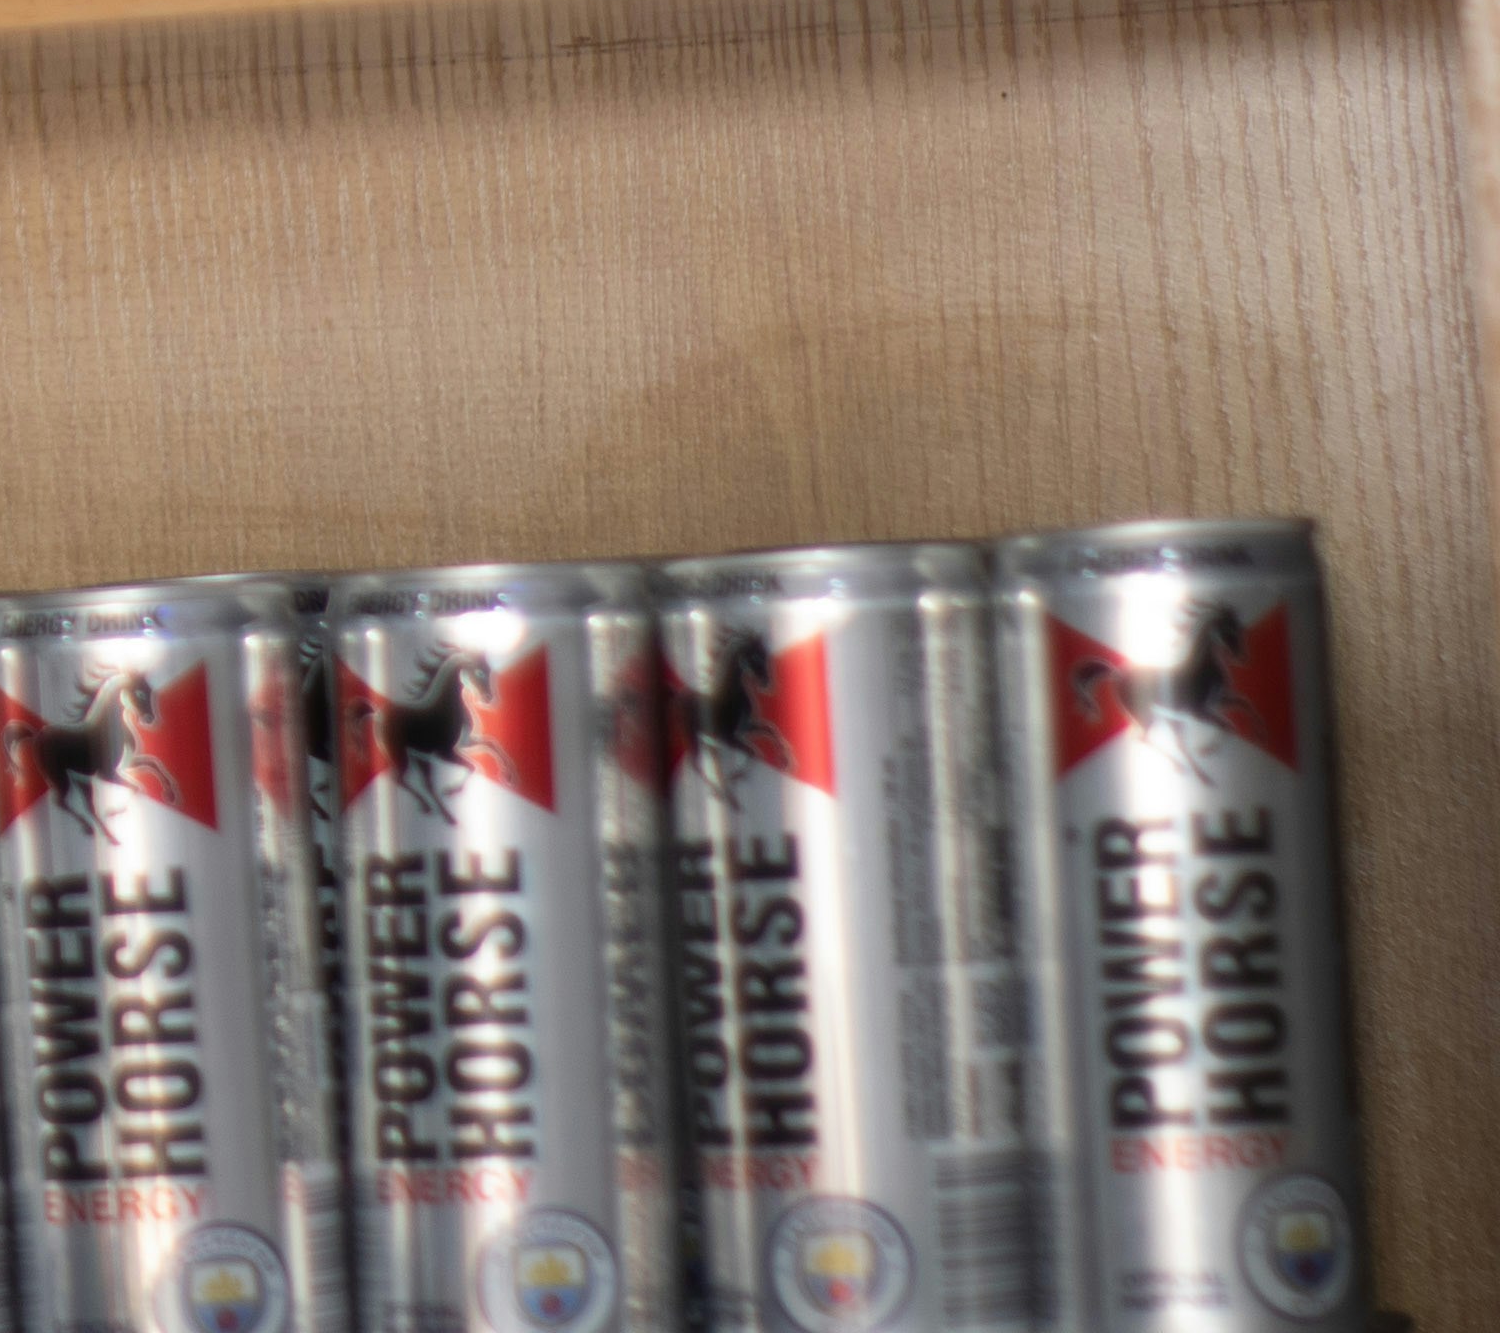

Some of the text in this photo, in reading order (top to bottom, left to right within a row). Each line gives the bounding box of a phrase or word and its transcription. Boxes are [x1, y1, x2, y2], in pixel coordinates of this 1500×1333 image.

[25, 871, 109, 1182] POWER
[103, 864, 209, 1178] HORSE
[364, 849, 438, 1162] POWER
[434, 846, 534, 1160] HORSE
[732, 829, 820, 1148] HORSE
[1093, 816, 1195, 1132] POWER
[1191, 805, 1291, 1127] HORSE
